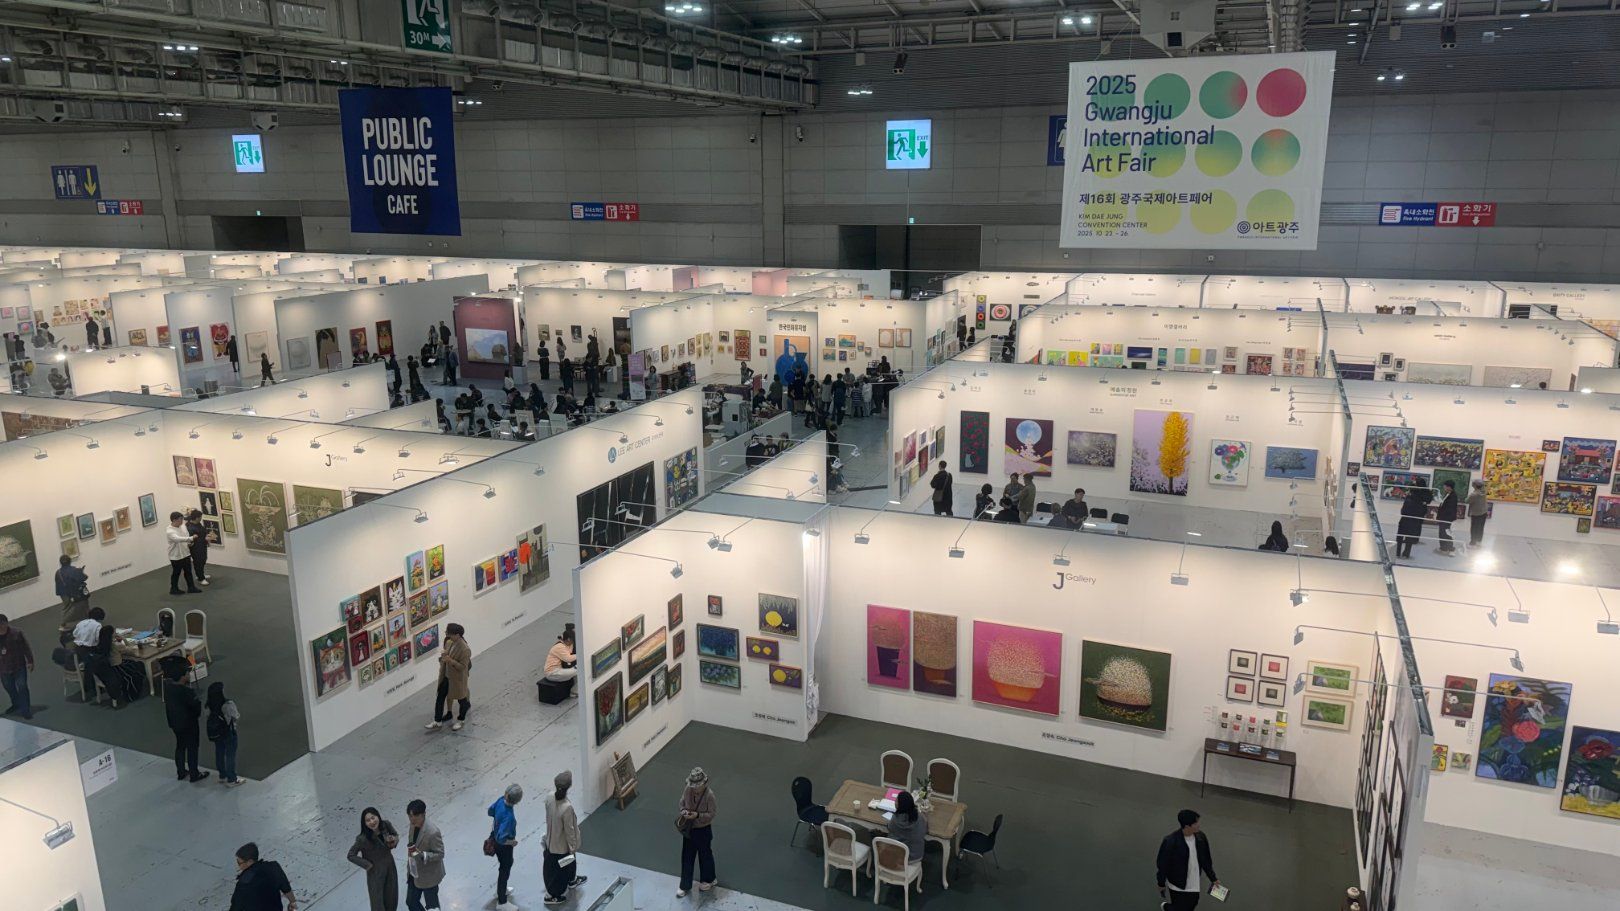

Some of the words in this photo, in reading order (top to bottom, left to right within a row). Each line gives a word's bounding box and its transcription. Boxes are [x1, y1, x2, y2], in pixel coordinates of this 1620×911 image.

[1086, 74, 1136, 95] 2025
[1085, 100, 1172, 125] Gwangju
[361, 117, 433, 150] PUBLIC
[1083, 125, 1215, 147] International
[361, 154, 439, 187] LOUNGE
[1081, 153, 1113, 172] Art
[1118, 152, 1157, 172] Fair
[387, 194, 419, 215] CAFE
[1079, 192, 1116, 205] 제16회
[1119, 192, 1213, 205] 광주국제아트페어
[1463, 204, 1492, 213] 소화기
[1252, 221, 1300, 234] 아트광주
[1052, 571, 1065, 590] J
[1065, 573, 1097, 585] Gallery
